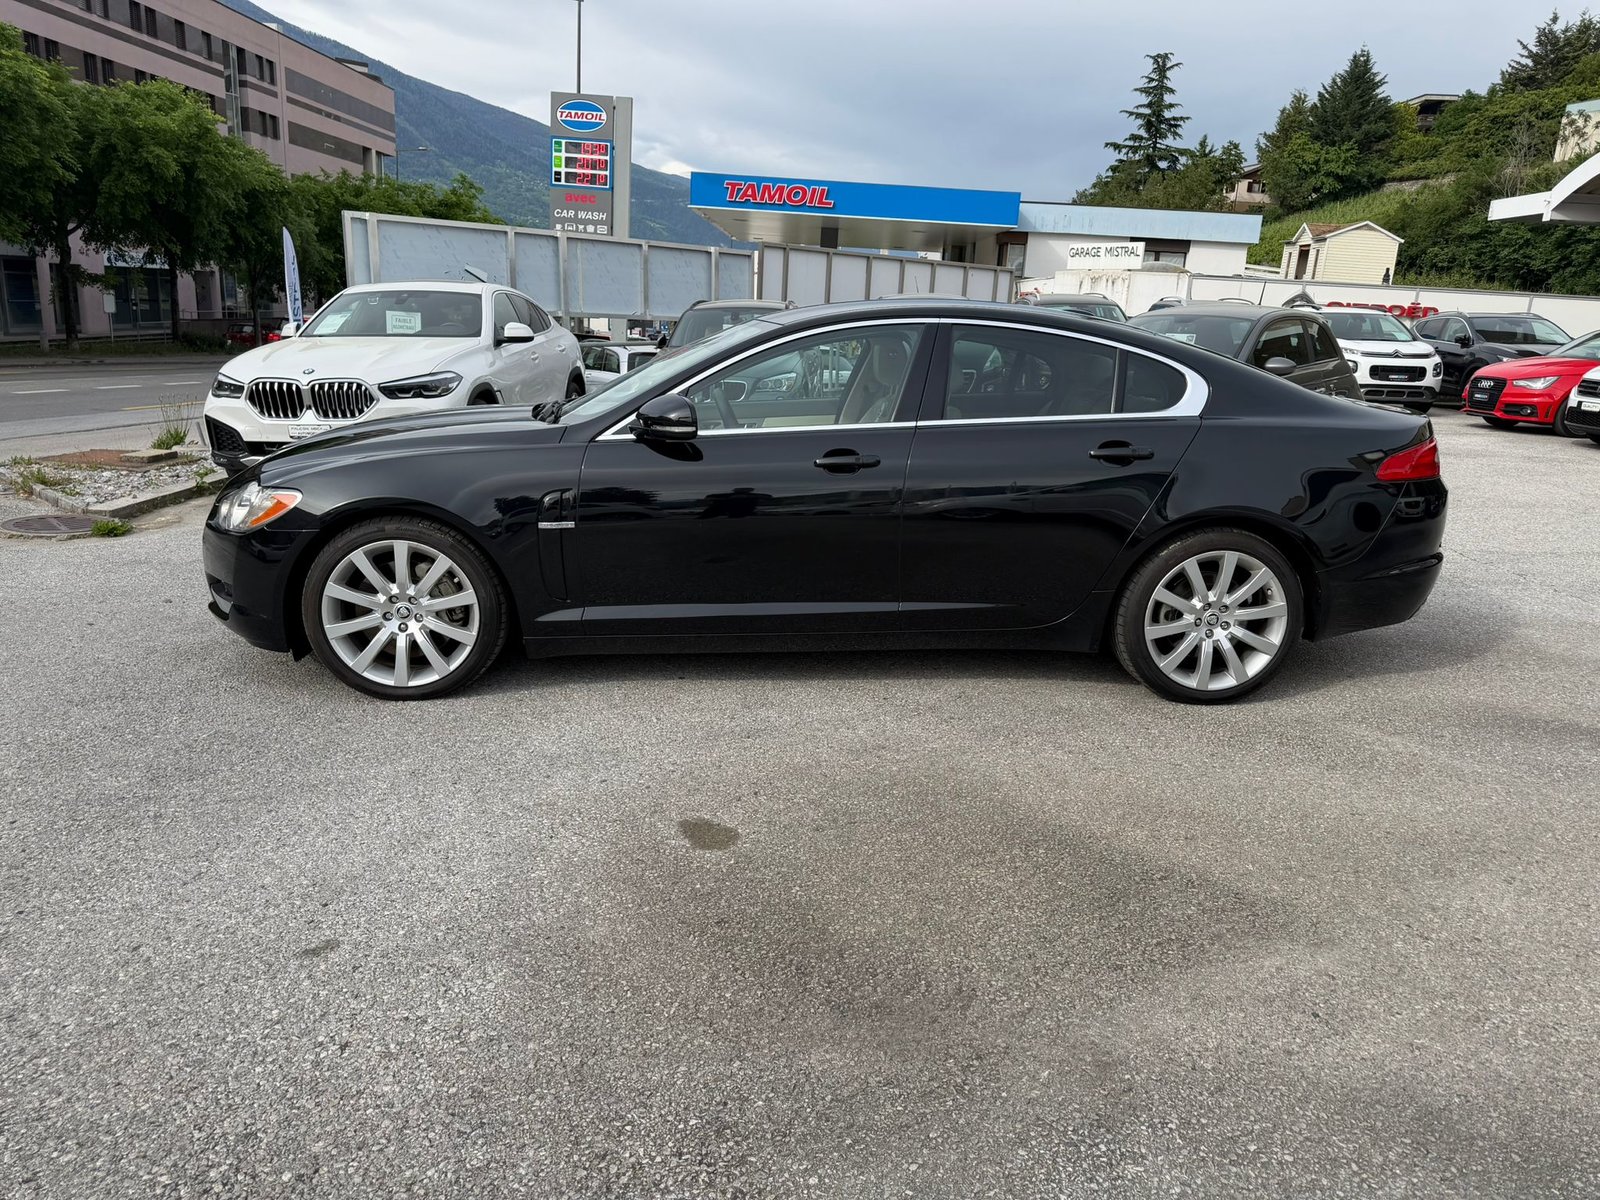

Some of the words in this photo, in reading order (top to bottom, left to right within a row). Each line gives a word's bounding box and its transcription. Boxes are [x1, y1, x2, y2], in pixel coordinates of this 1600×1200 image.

[559, 111, 606, 121] TAMOIL
[565, 193, 597, 205] avec
[724, 180, 835, 208] TAMOIL
[554, 208, 575, 219] CAR
[577, 210, 607, 221] WASH
[1068, 246, 1102, 258] GARAGE
[1104, 245, 1141, 257] MISTRAL
